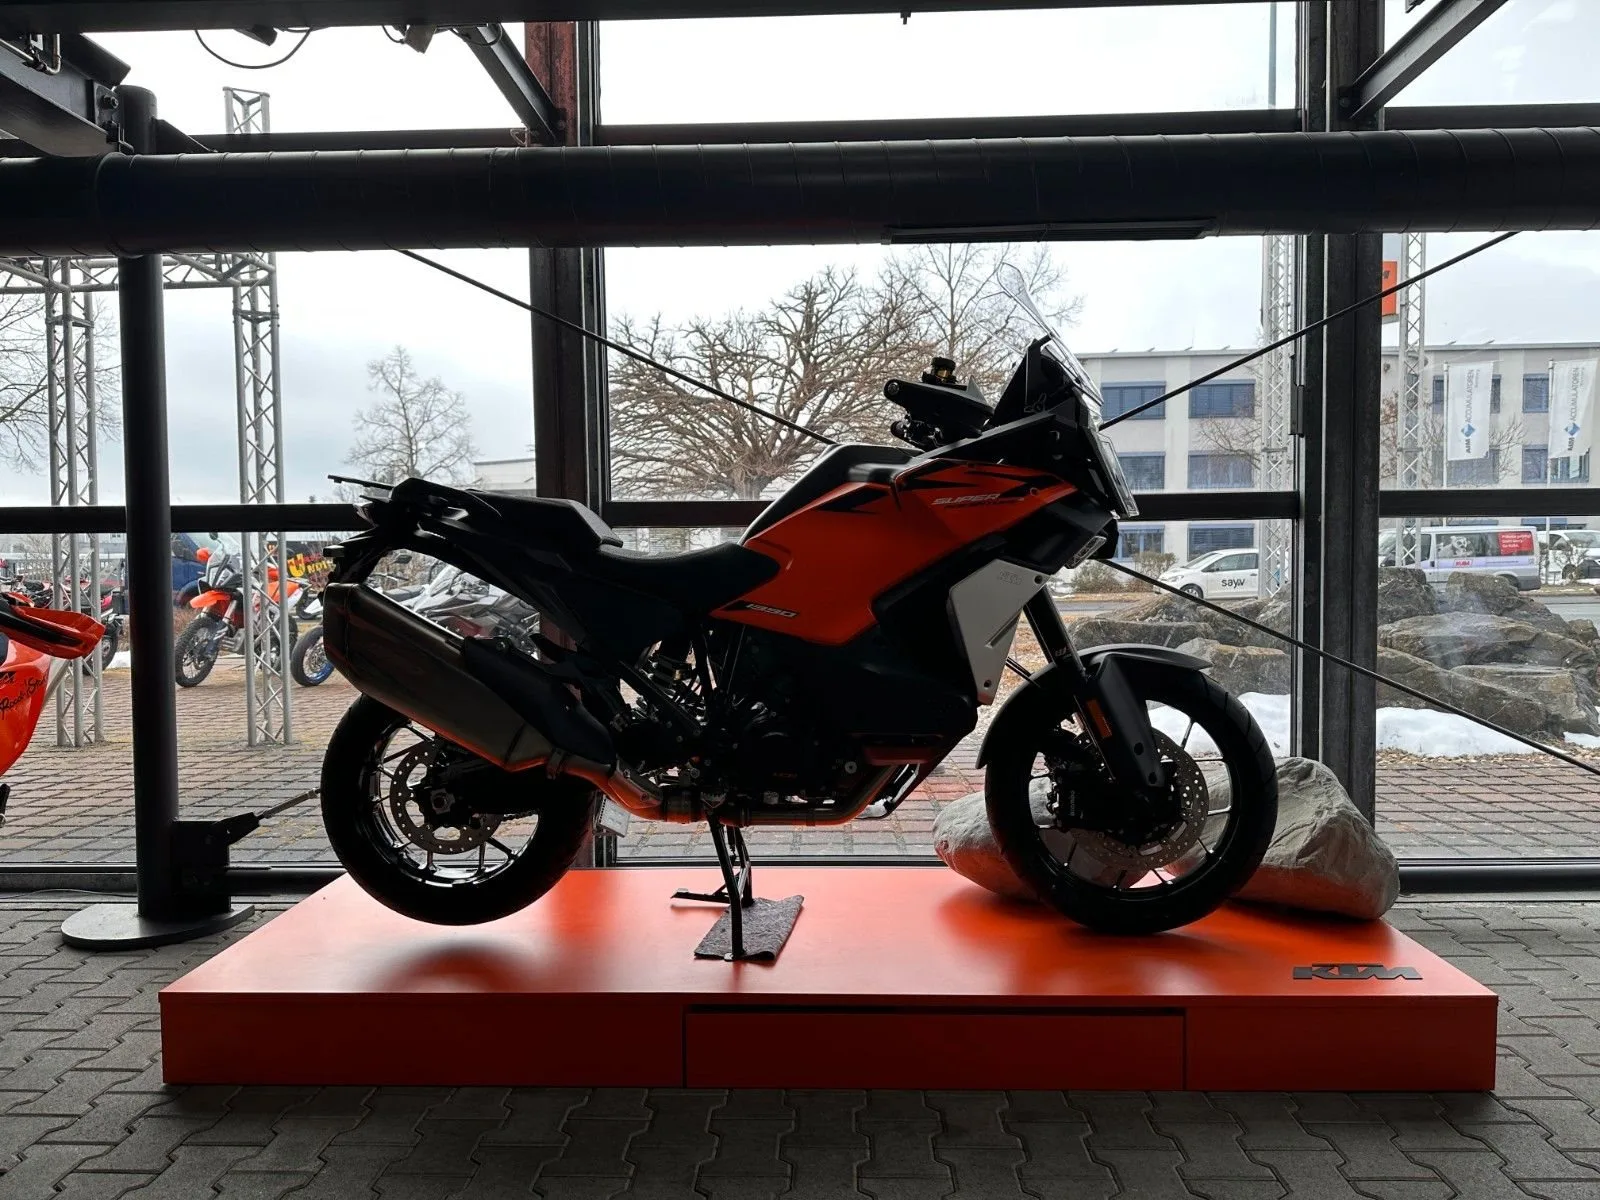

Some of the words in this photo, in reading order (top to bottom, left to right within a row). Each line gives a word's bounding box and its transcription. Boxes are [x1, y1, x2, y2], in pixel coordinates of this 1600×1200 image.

[1464, 369, 1474, 423] ACCUMULATOREN
[1570, 367, 1579, 421] ACCUMULATOREN
[1464, 438, 1472, 453] AIM
[931, 493, 1000, 505] SUPER
[1293, 963, 1423, 980] KTM
